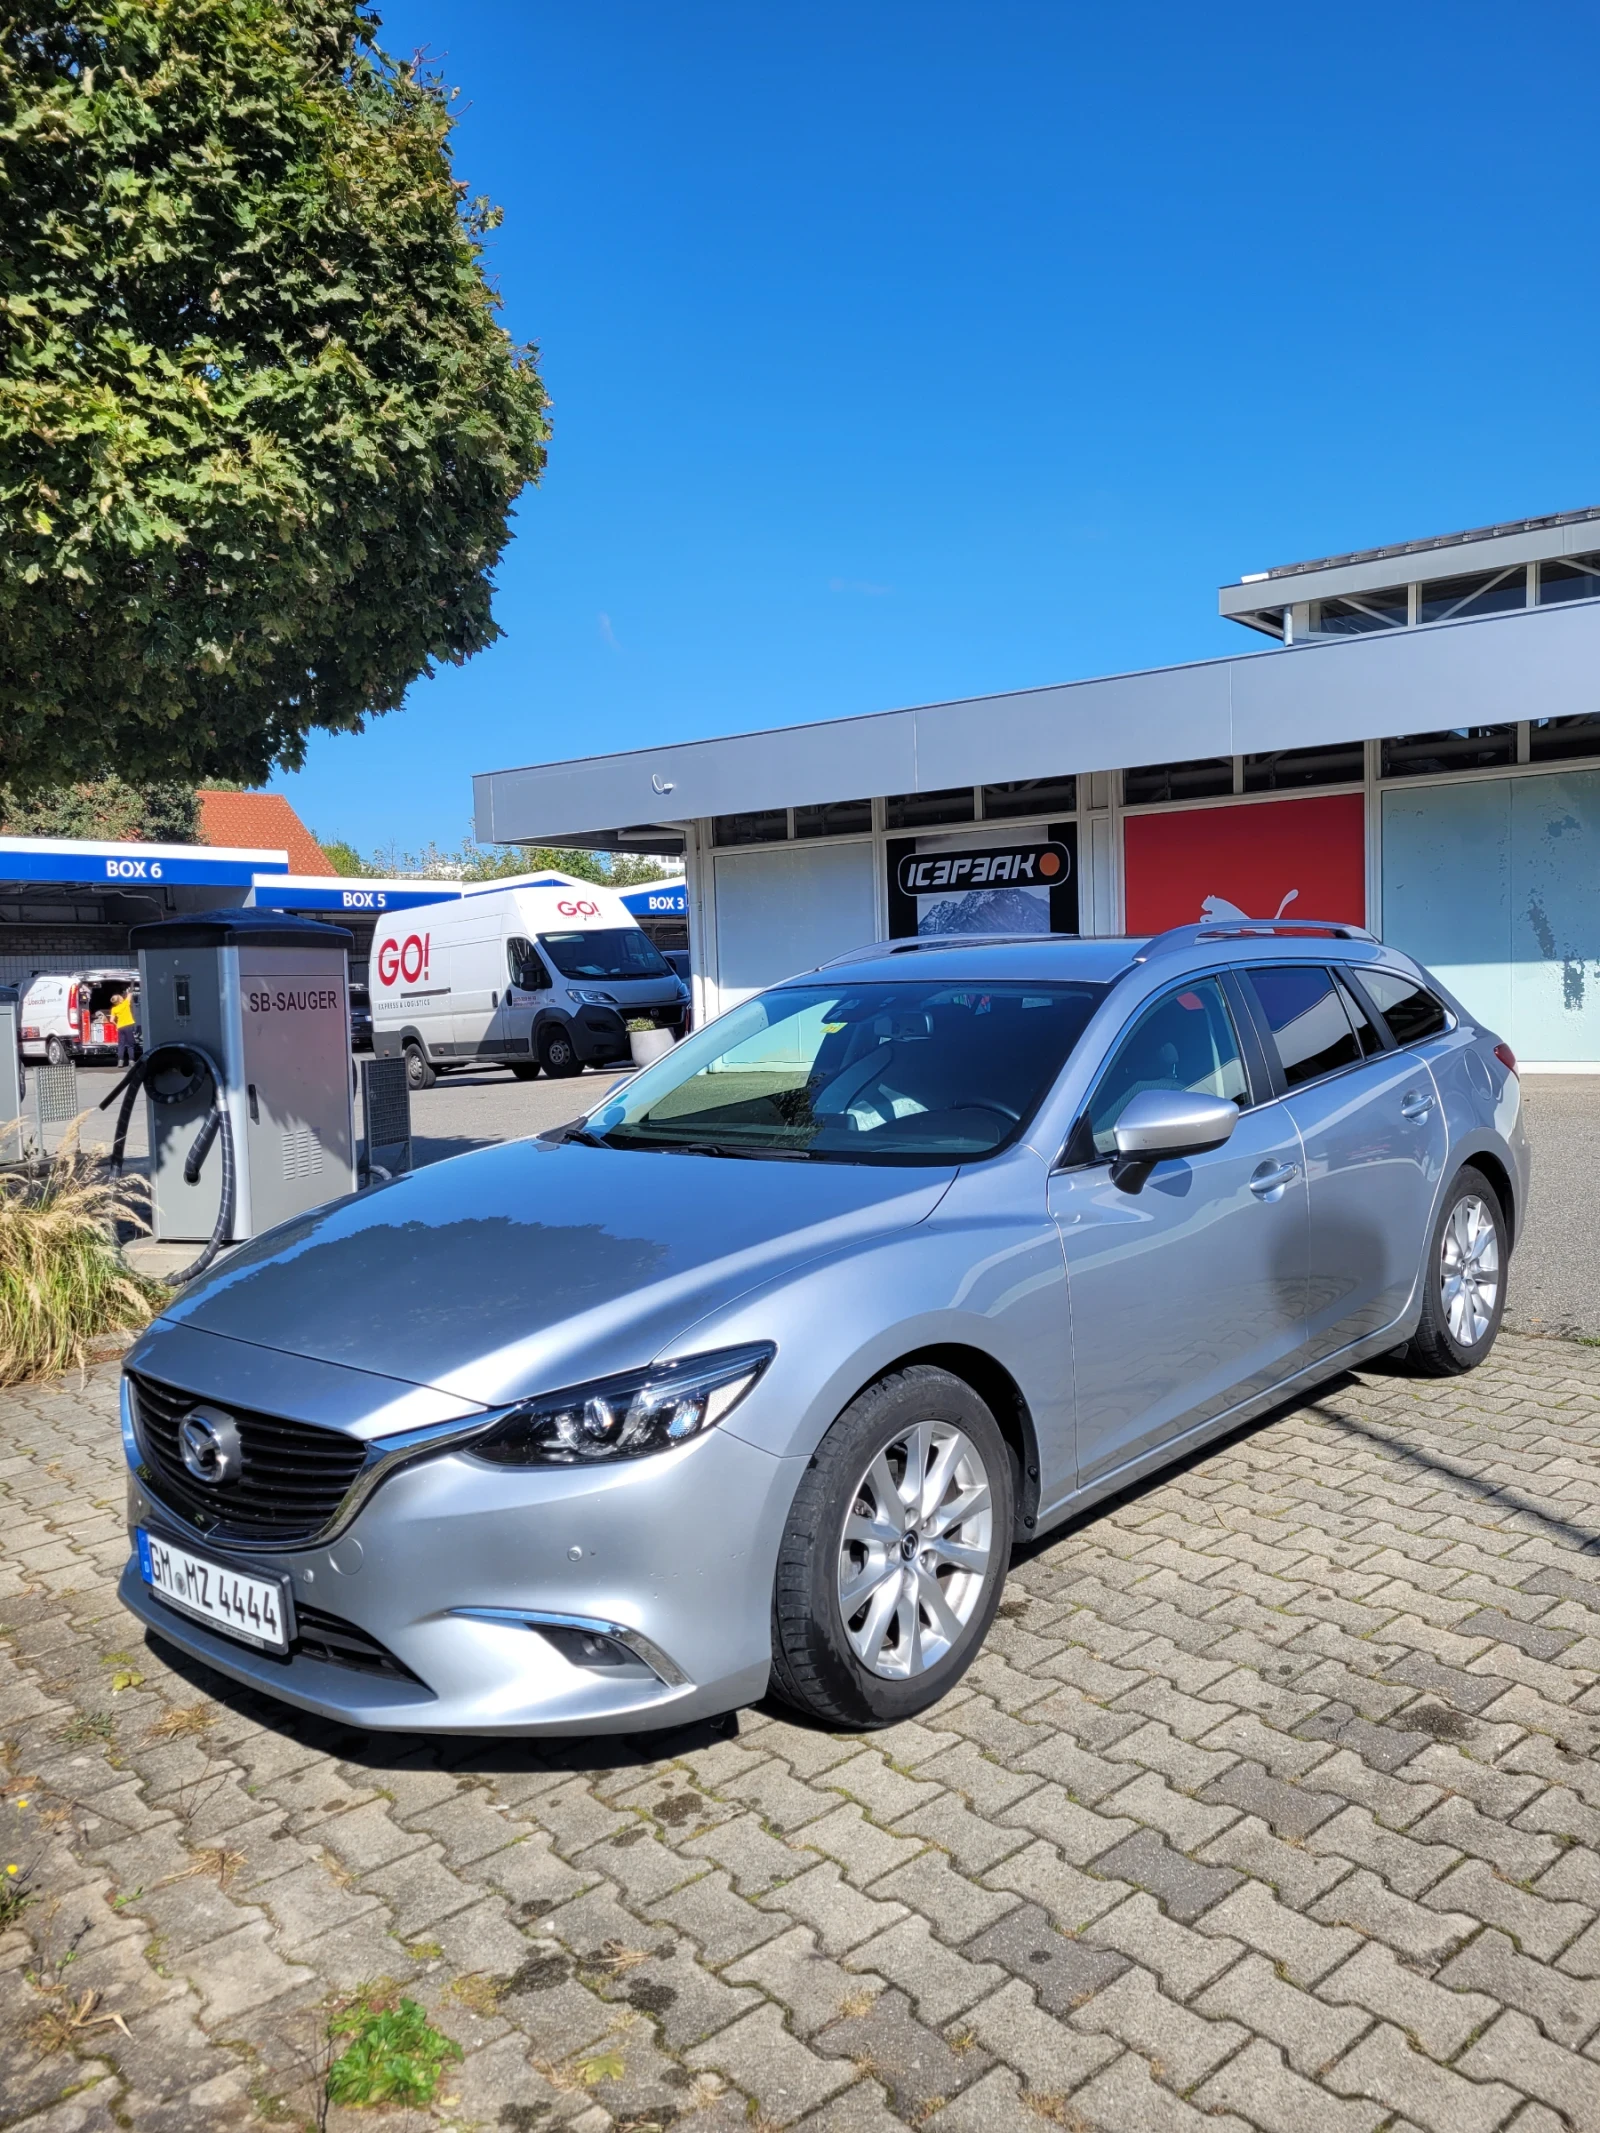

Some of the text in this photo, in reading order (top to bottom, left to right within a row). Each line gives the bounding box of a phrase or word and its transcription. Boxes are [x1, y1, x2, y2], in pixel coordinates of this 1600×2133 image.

[106, 860, 162, 879] BOX 6
[907, 853, 1036, 887] ICEPEAK
[343, 892, 386, 907] BOX 5
[557, 901, 601, 916] GO!
[648, 897, 684, 909] BOX 3
[378, 932, 430, 986] GO!
[250, 990, 338, 1012] SB-SAUGER
[378, 1002, 399, 1010] EXPRESS
[404, 999, 430, 1008] LOGISTICS
[150, 1541, 277, 1635] GM MZ 4444
